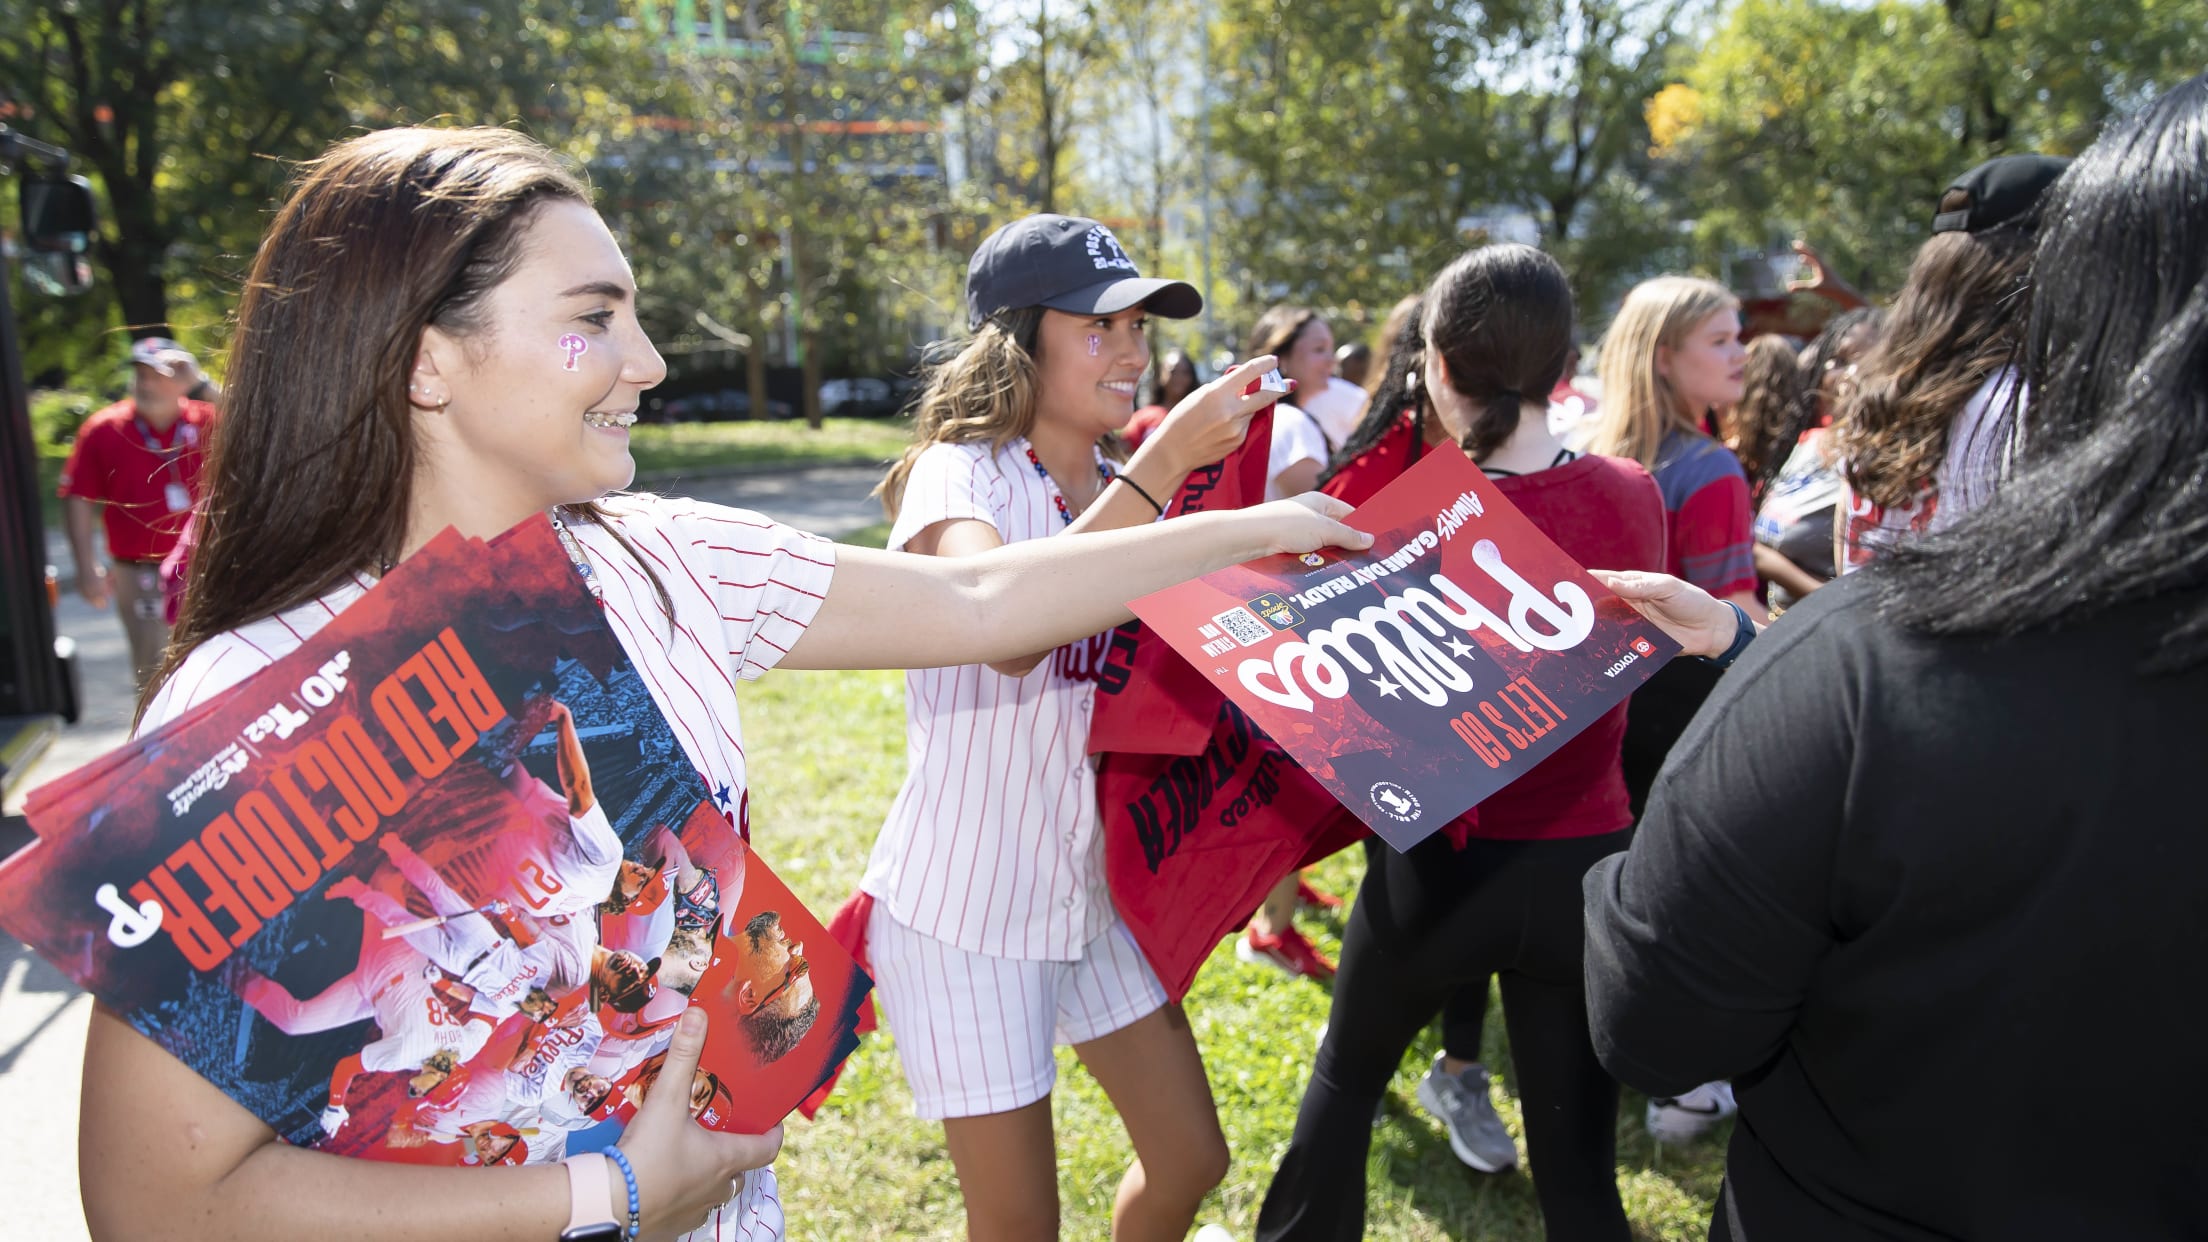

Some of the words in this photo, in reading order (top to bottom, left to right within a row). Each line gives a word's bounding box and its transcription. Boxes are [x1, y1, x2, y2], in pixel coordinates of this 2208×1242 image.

[558, 332, 588, 372] P
[1237, 538, 1595, 713] Phillies
[1603, 651, 1639, 678] TOYOTA
[370, 625, 508, 780] RED
[1478, 675, 1568, 750] LET'S
[1450, 711, 1512, 769] GO
[1126, 699, 1253, 875] CTOBER
[127, 714, 409, 972] OCTOBER
[95, 882, 164, 949] P
[509, 858, 563, 910] 27
